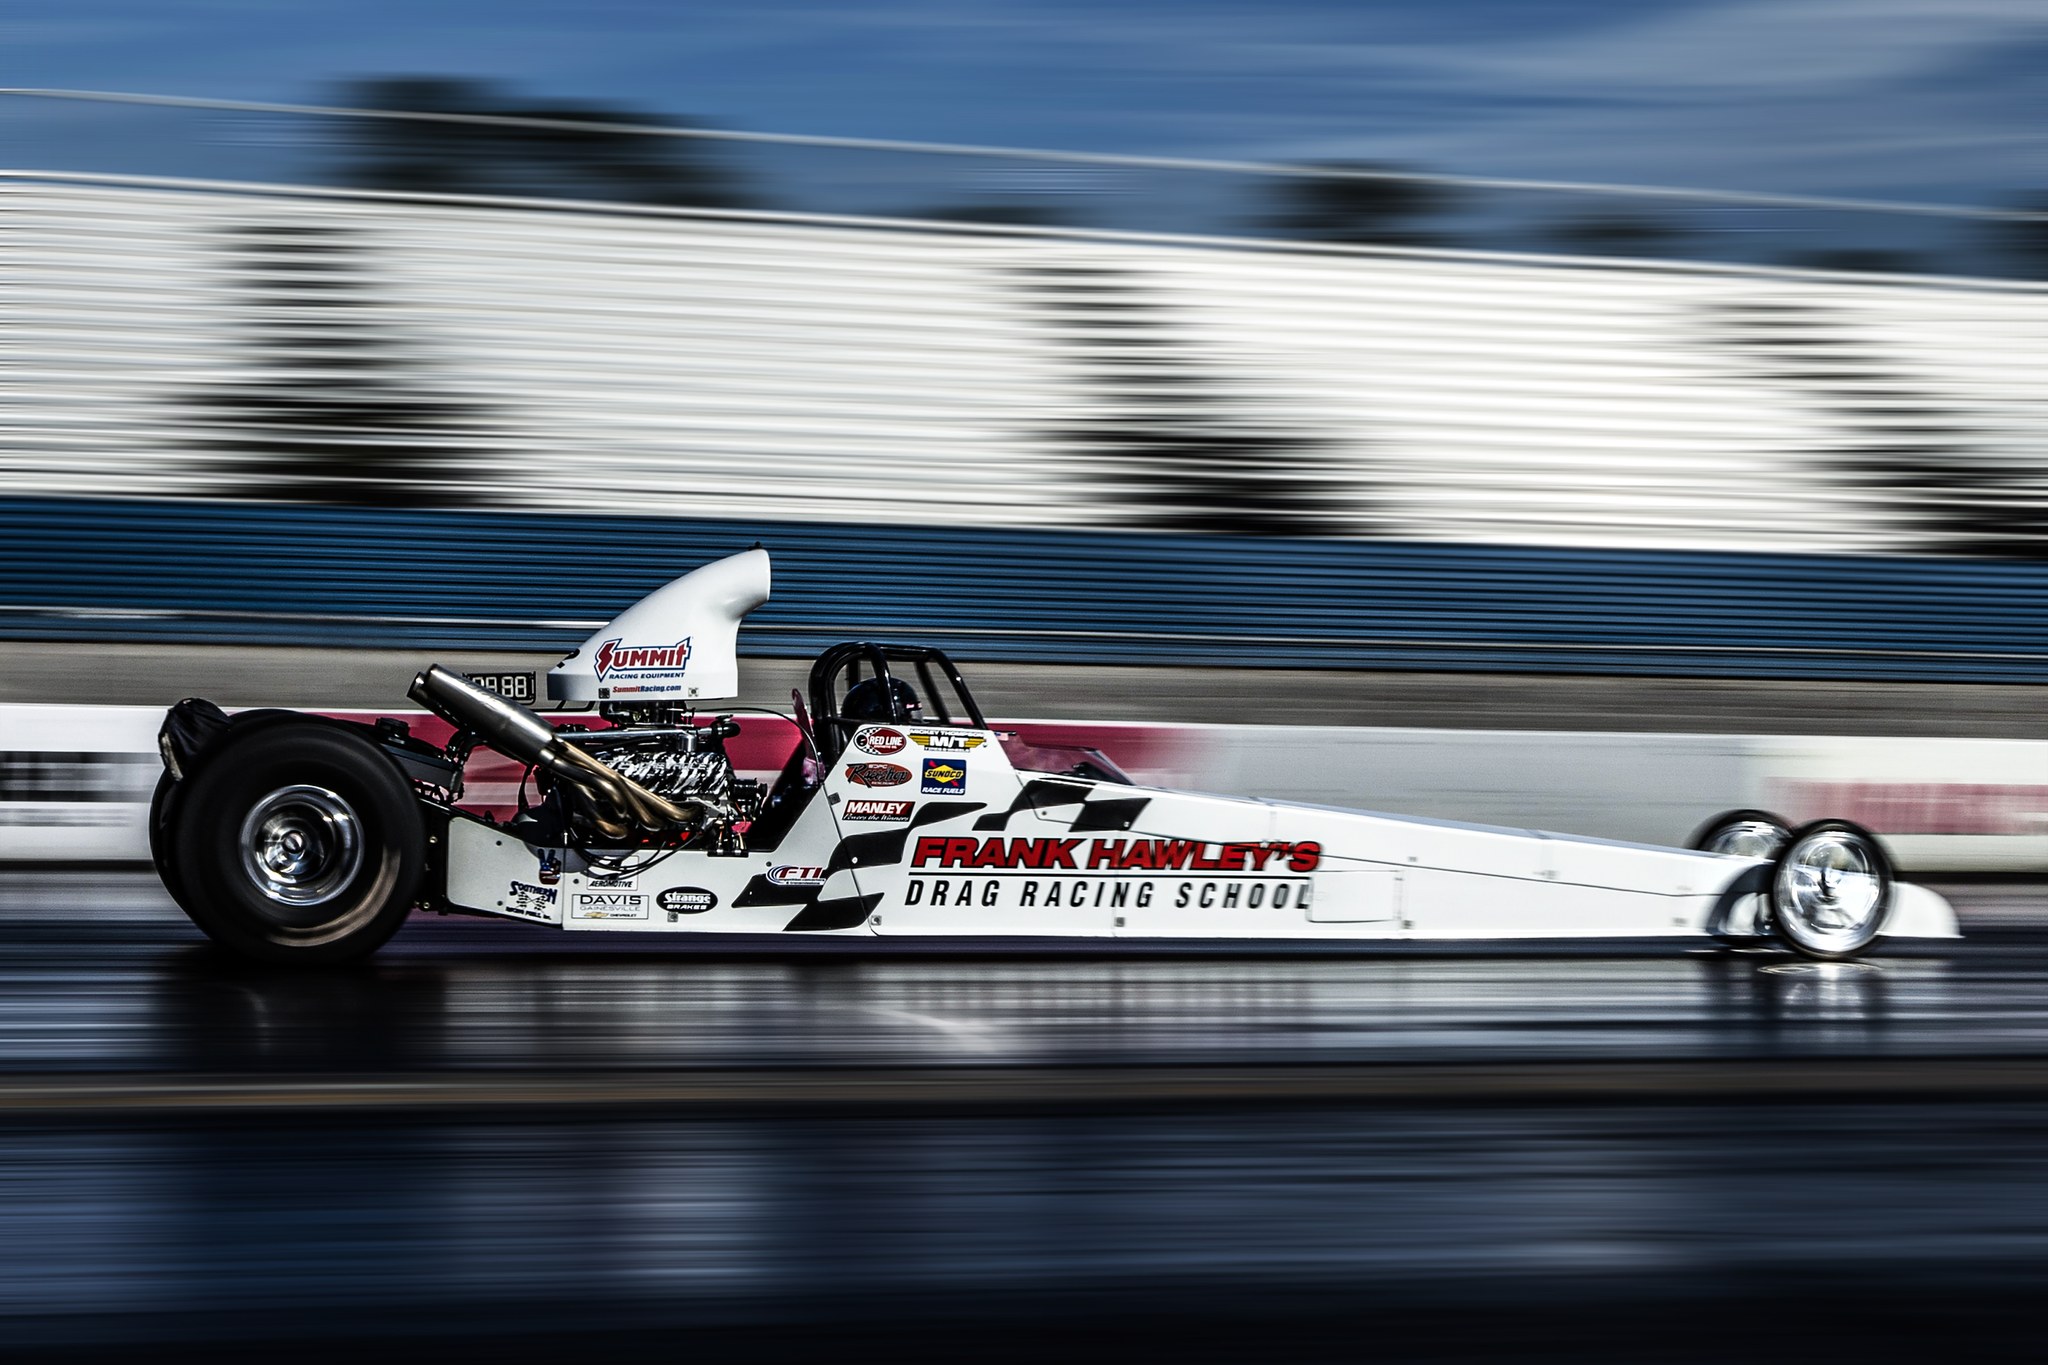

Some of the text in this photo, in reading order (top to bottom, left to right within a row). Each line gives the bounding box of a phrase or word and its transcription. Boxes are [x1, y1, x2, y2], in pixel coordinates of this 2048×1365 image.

[640, 671, 685, 679] EQUIPMENT
[612, 684, 682, 694] SummitRacing.com
[869, 735, 904, 746] RED LINE
[929, 735, 969, 748] M/T
[926, 770, 962, 778] SUNOCO
[847, 801, 907, 815] MANLEY
[910, 836, 1323, 873] FRANK HAWLEY'S
[778, 866, 823, 879] FTI
[589, 880, 633, 888] AEROMOTIVE
[580, 894, 642, 905] DAVIS
[663, 891, 711, 904] Strange
[904, 880, 1310, 909] DRAG RACING SCHOOL
